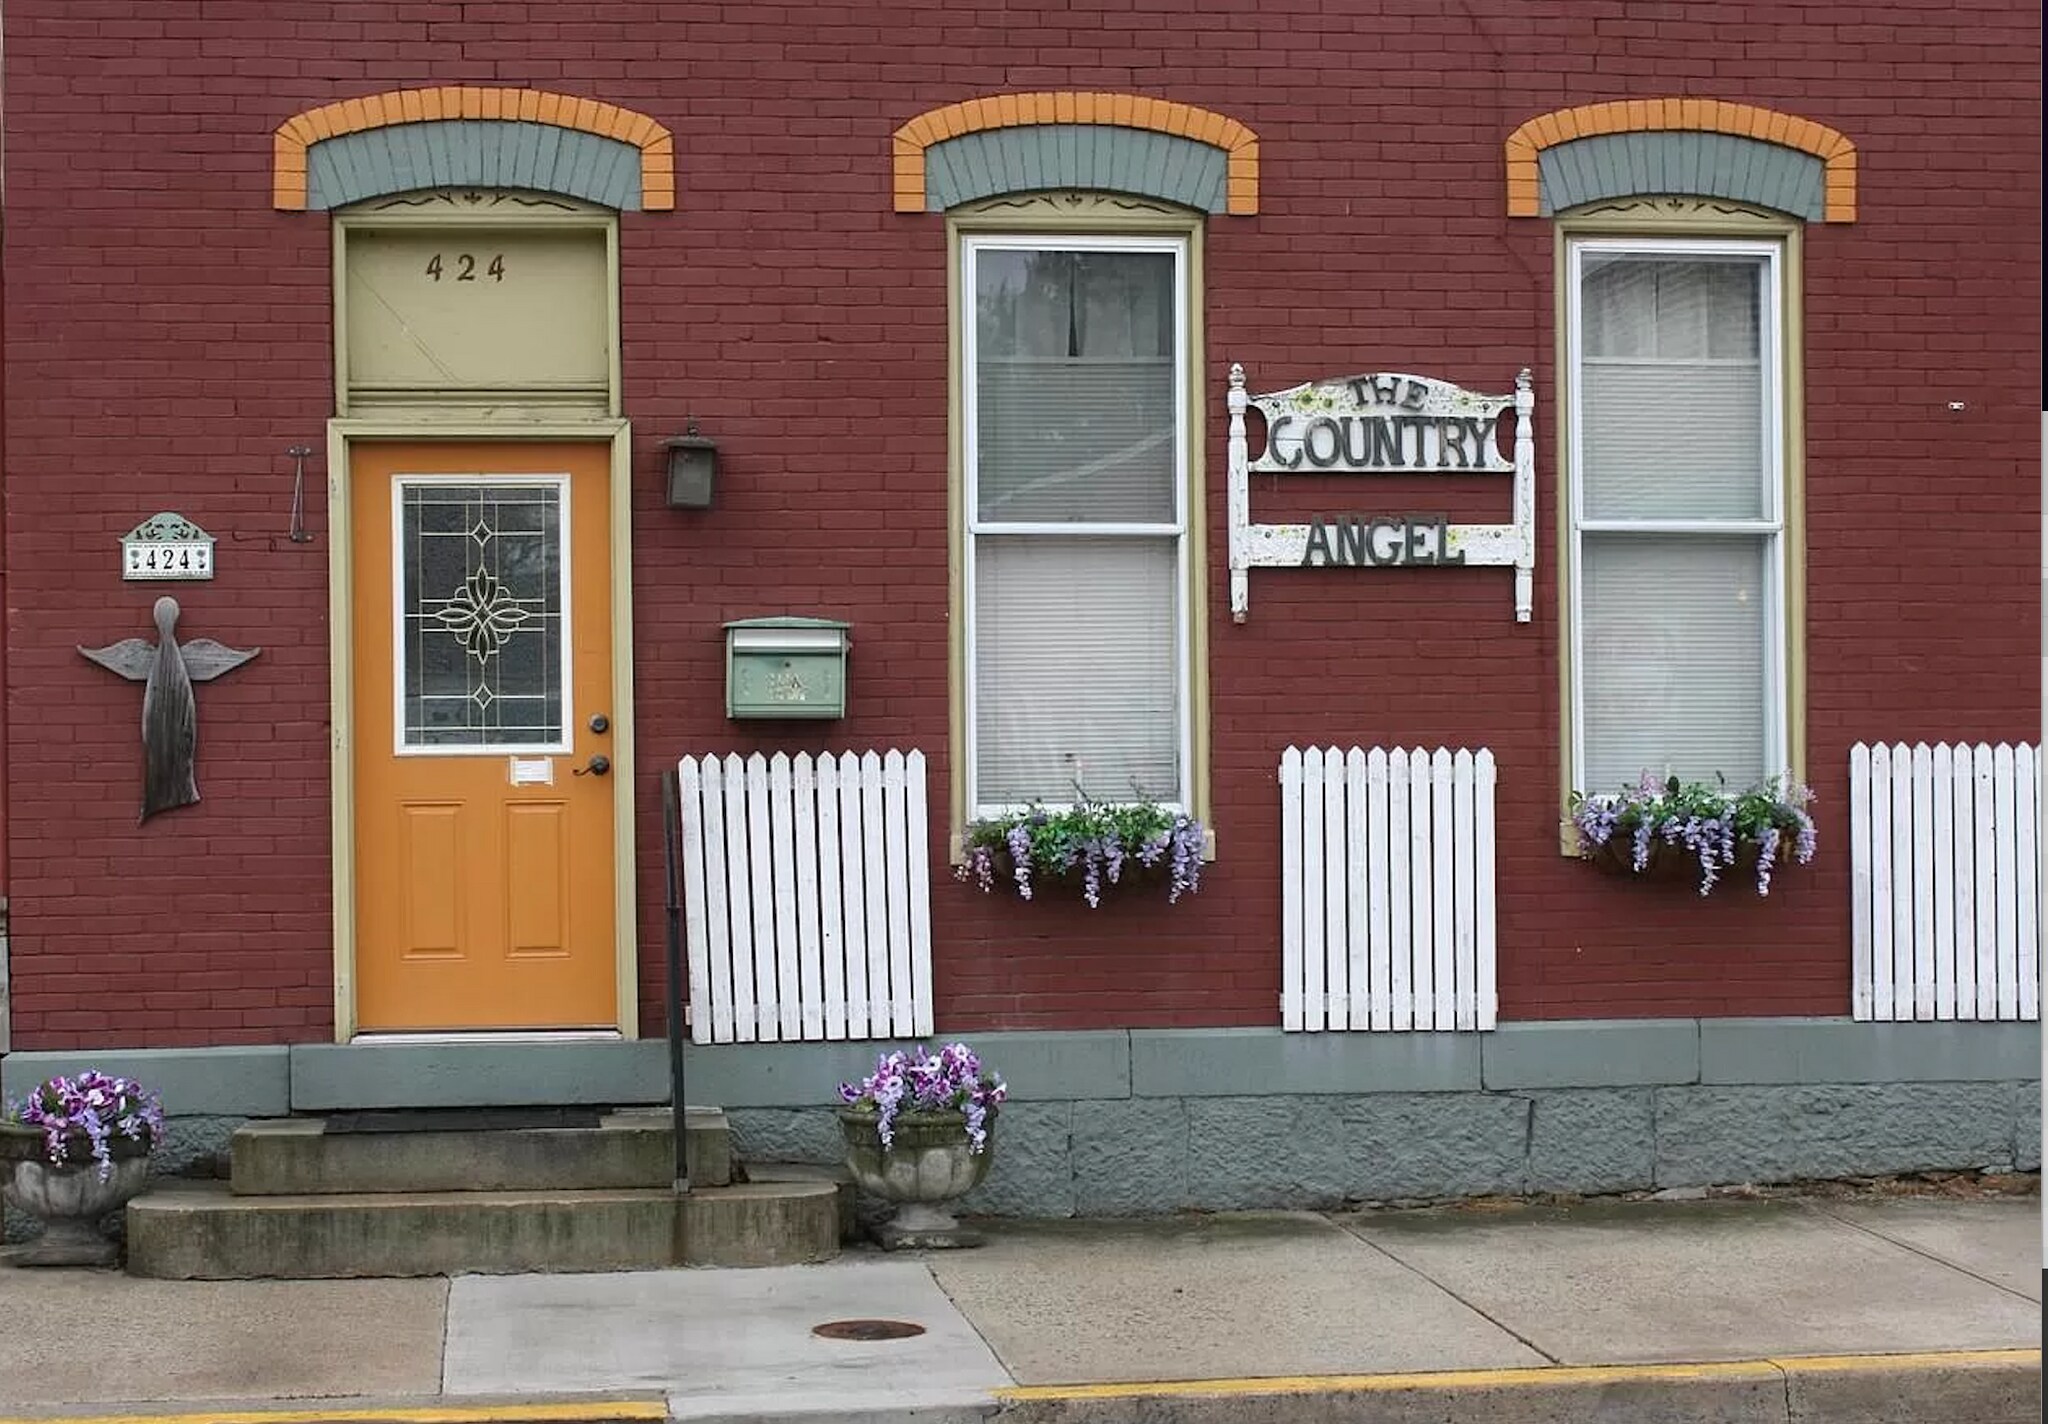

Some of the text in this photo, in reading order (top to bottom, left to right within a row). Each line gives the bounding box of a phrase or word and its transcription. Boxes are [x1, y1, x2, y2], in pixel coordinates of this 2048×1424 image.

[426, 254, 505, 281] 424
[1347, 376, 1429, 411] THE
[1268, 415, 1497, 469] COUNTRY
[1301, 512, 1465, 566] ANGEL
[146, 549, 190, 569] 424
